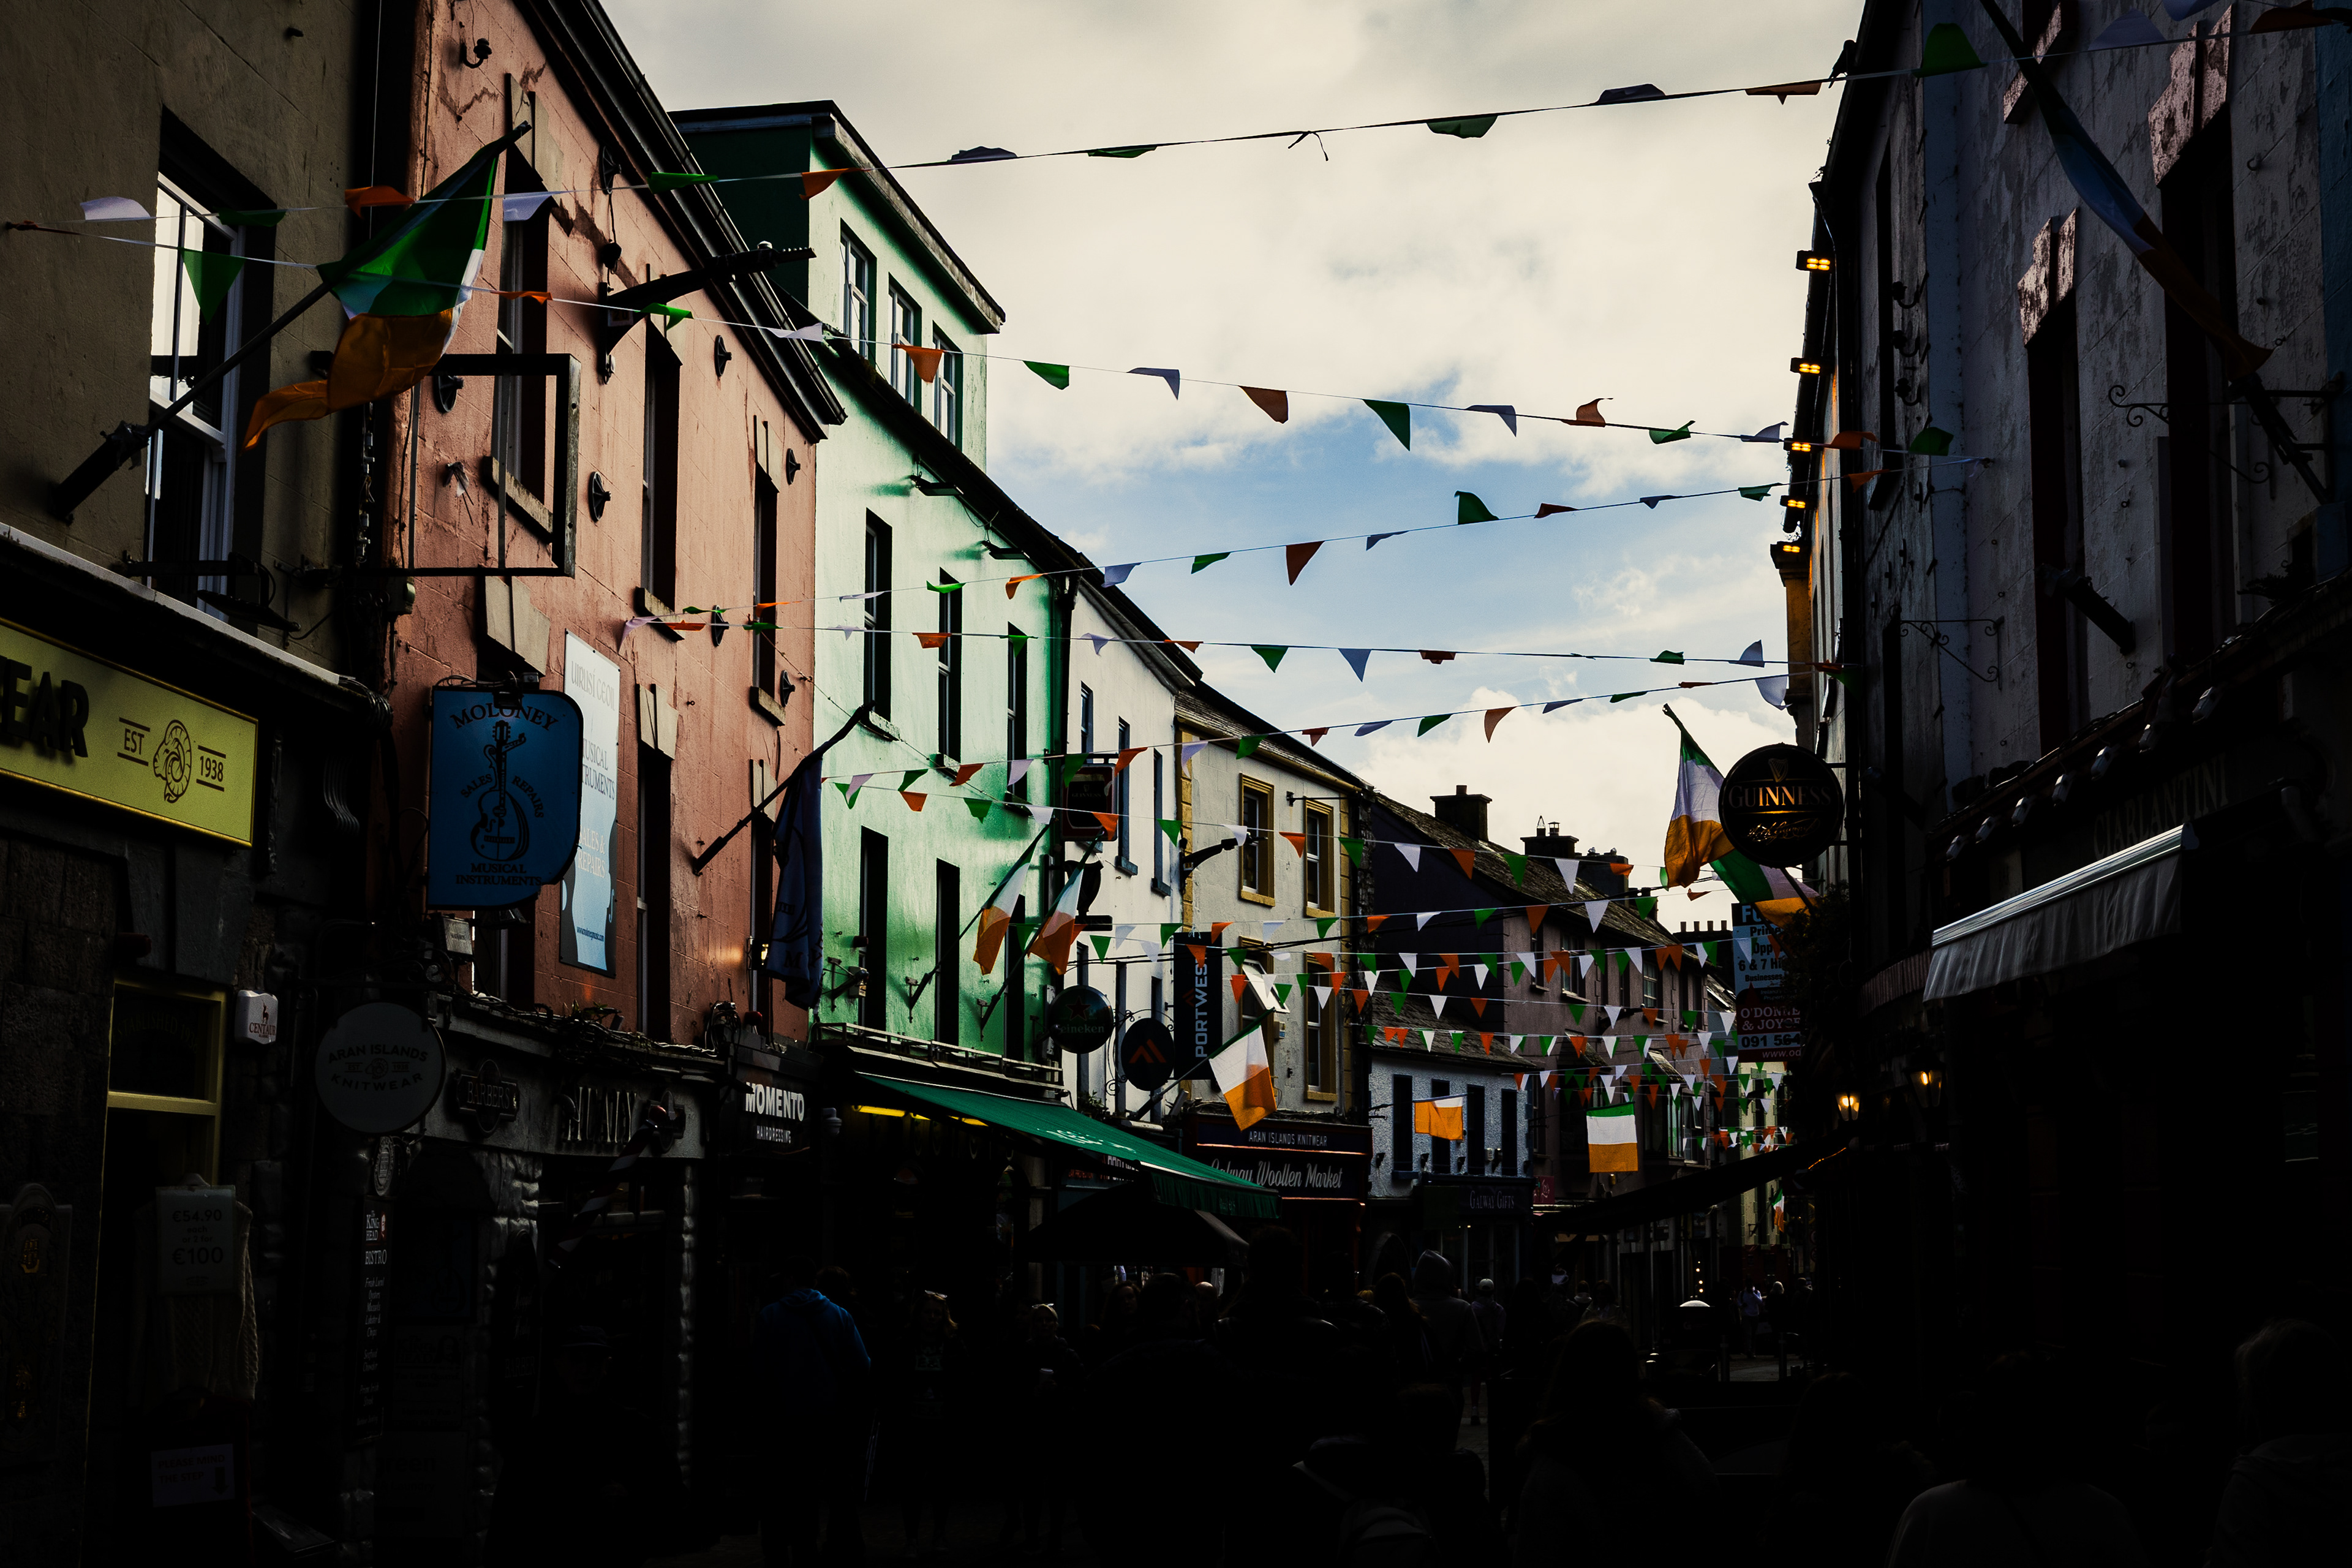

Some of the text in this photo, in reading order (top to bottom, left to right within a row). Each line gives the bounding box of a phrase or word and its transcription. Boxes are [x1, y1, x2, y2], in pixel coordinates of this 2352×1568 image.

[0, 655, 89, 758] EAR
[450, 701, 559, 731] MOLONEY
[124, 728, 145, 755] EST
[199, 755, 224, 783] 1938
[461, 772, 492, 798] SALES
[582, 764, 616, 801] TRUMENTS
[511, 775, 545, 819] REPAIRS
[1728, 785, 1832, 809] GUINNESS
[2093, 752, 2229, 860] CIARLANTINI
[470, 862, 527, 874] MUSICAL
[578, 850, 606, 879] REPAIRS
[455, 874, 543, 886] INSTRUMENTS
[1738, 960, 1746, 971] 6
[1749, 960, 1758, 971] &
[1760, 959, 1766, 970] 7
[1195, 957, 1208, 1058] PORTWES
[1741, 1006, 1801, 1019] O'DONNE
[111, 1012, 178, 1046] ESTABLISHED
[249, 1022, 276, 1036] CENTAUR
[1060, 1023, 1105, 1034] eineken
[1742, 1020, 1754, 1031] &
[1741, 1035, 1767, 1048] 091
[328, 1044, 429, 1065] ARAN ISLANDS
[331, 1073, 424, 1091] KNITWEAR
[467, 1081, 510, 1110] BARBERS
[745, 1081, 805, 1122] MOMENTO
[756, 1125, 791, 1144] HAIRDRESSING
[1248, 1131, 1328, 1147] ARAN ISLANDS KNITWEAR
[1256, 1160, 1303, 1187] Woollen
[1305, 1162, 1343, 1189] Market
[172, 1208, 222, 1223] €54.90
[186, 1225, 208, 1234] each
[193, 1235, 199, 1243] 2
[200, 1234, 213, 1243] for
[366, 1230, 379, 1241] HEAD
[172, 1246, 224, 1265] €100
[364, 1249, 388, 1265] BISTRO
[396, 1354, 434, 1363] HEAD
[504, 1355, 536, 1379] BARBER
[158, 1454, 225, 1469] PLEASE MIND
[159, 1471, 205, 1485] THE STEP
[391, 1479, 435, 1493] Laundry
